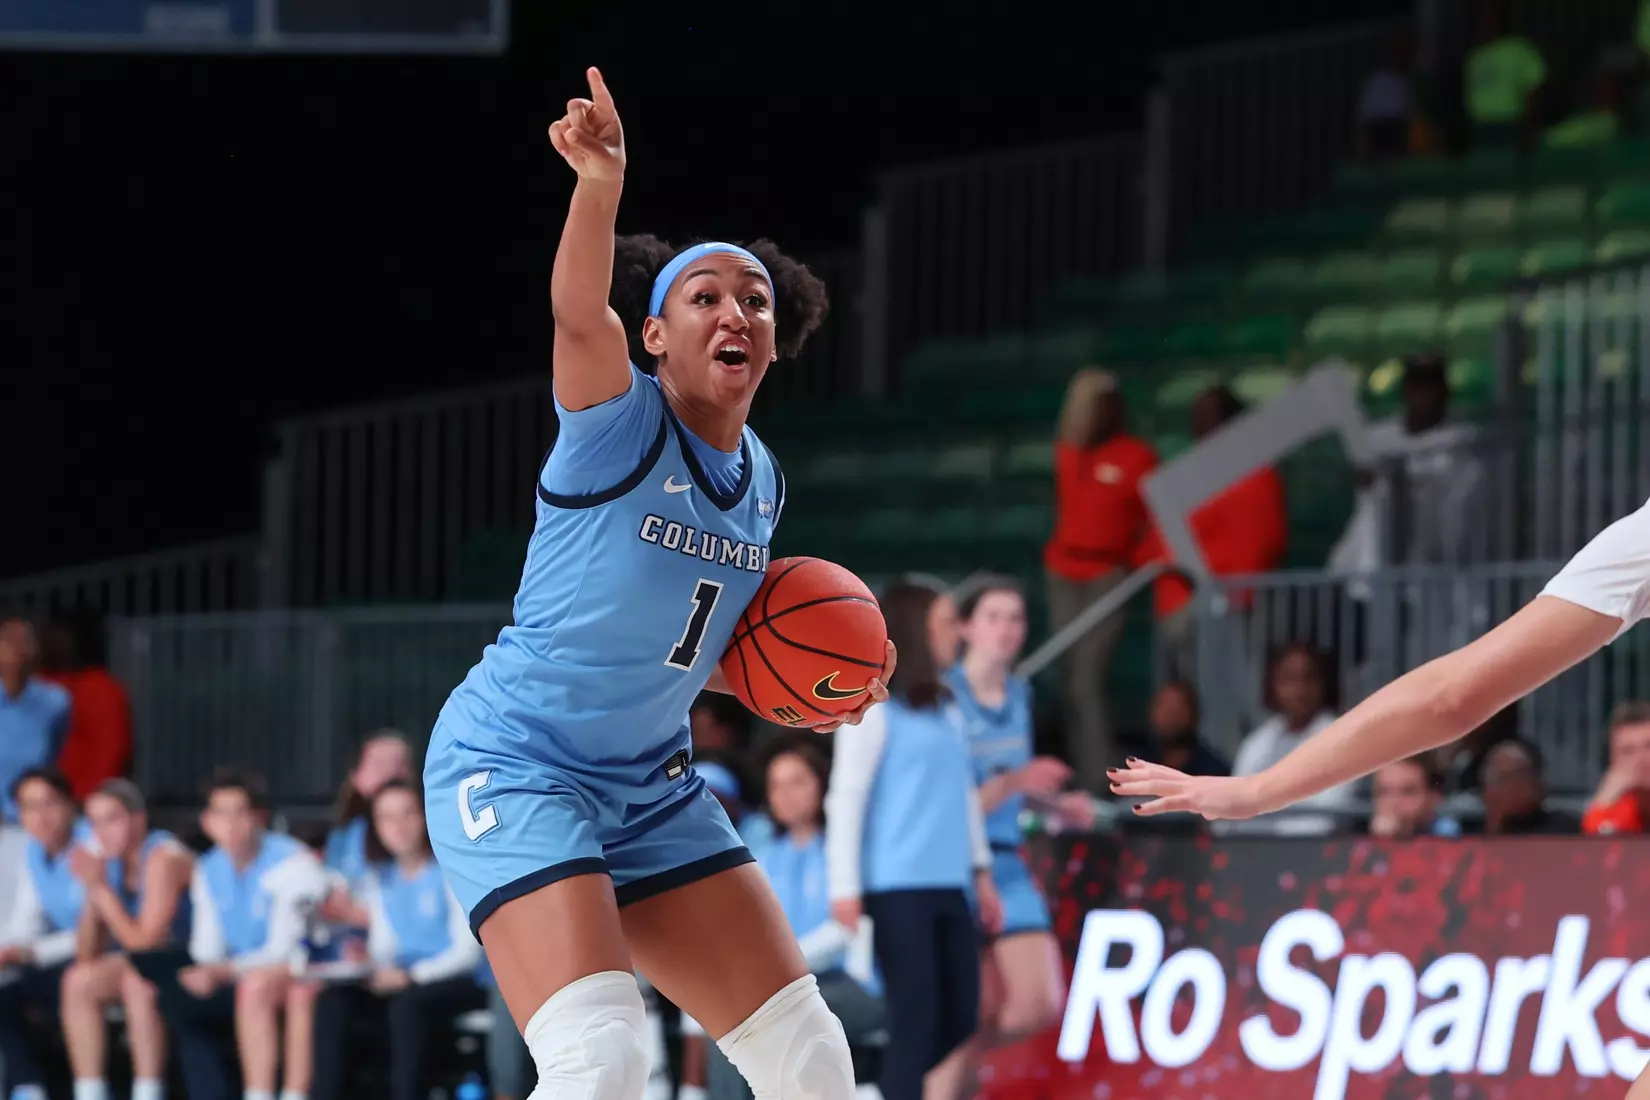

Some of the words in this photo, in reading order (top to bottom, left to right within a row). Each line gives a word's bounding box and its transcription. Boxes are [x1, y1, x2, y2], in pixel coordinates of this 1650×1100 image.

[664, 578, 724, 672] 1
[457, 768, 502, 843] C
[1057, 908, 1227, 1068] Ro
